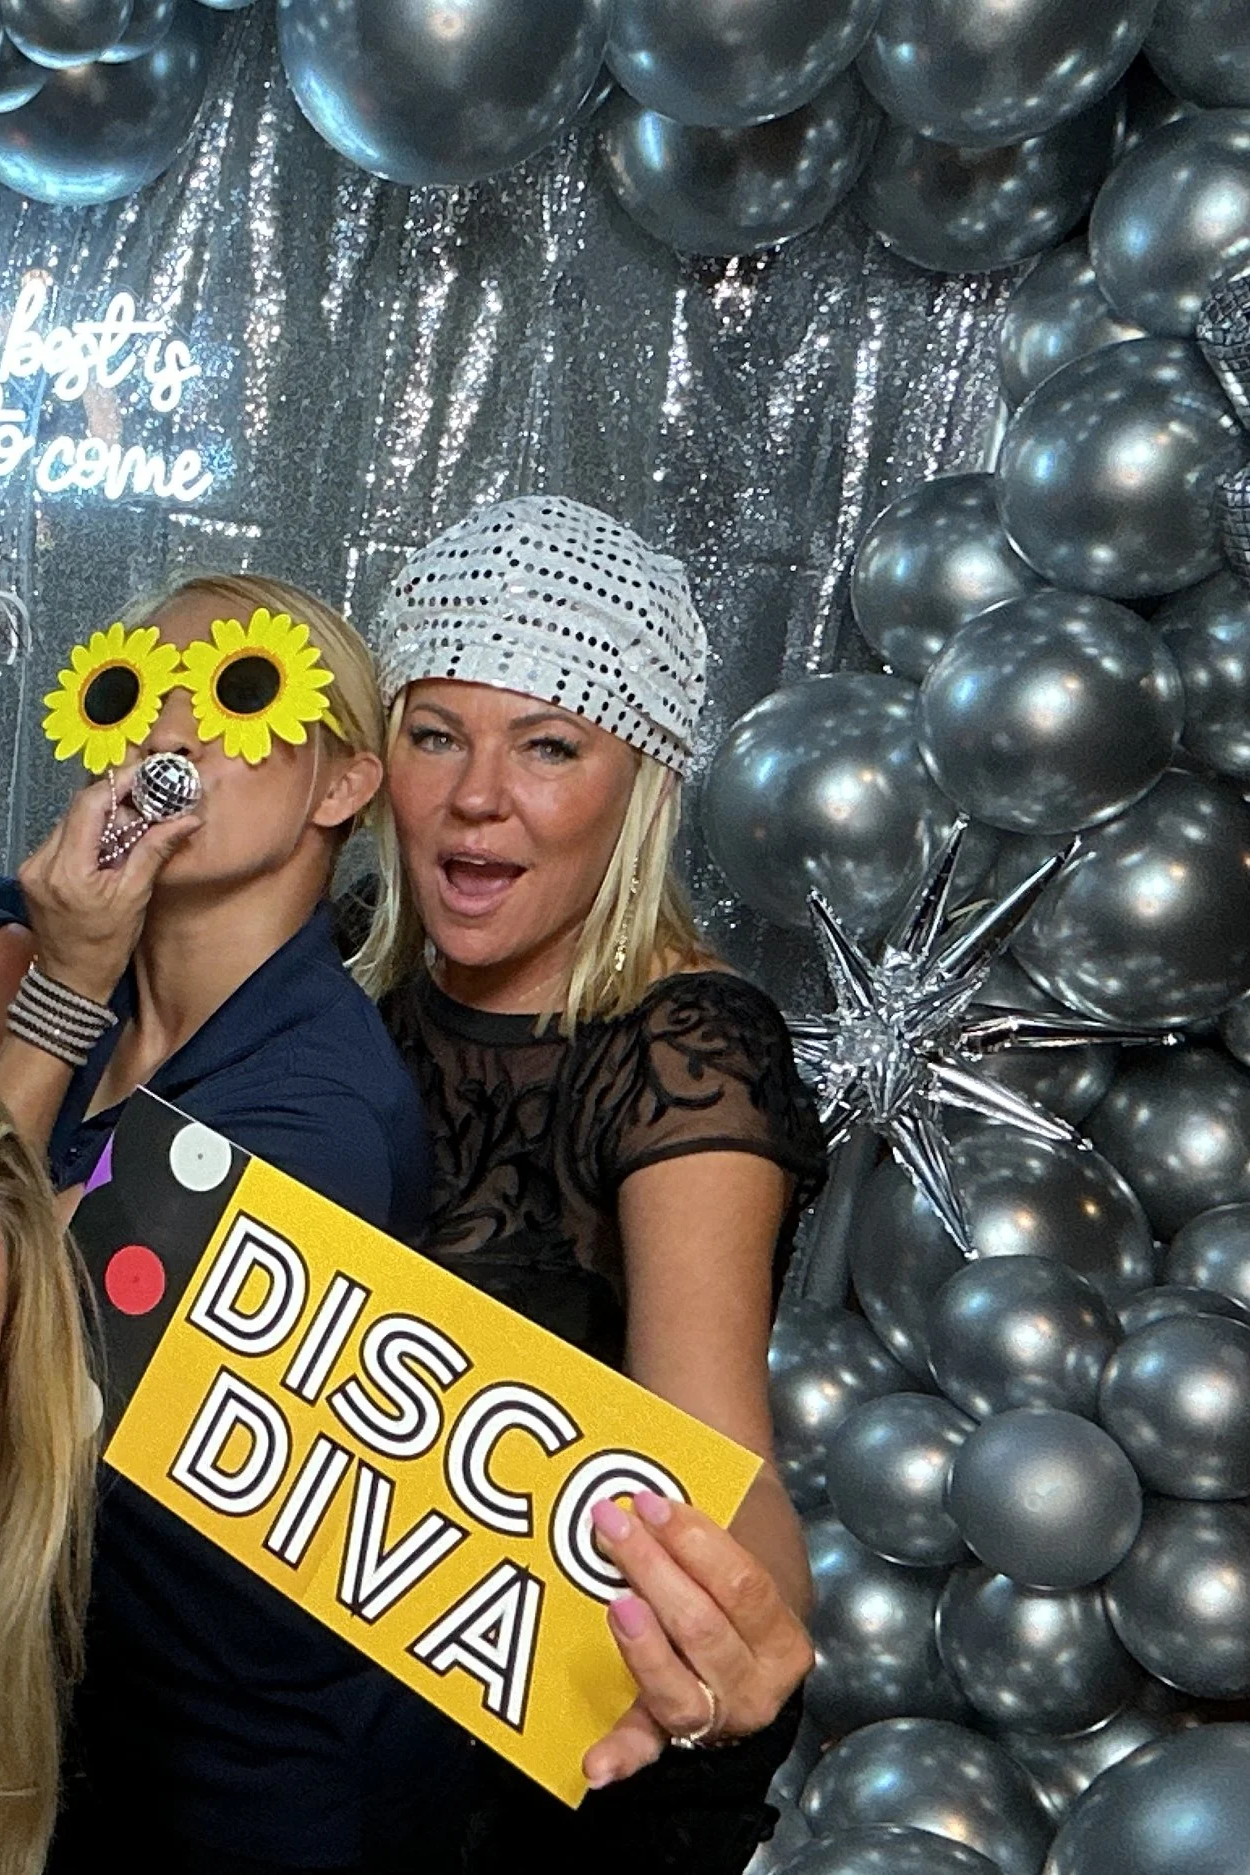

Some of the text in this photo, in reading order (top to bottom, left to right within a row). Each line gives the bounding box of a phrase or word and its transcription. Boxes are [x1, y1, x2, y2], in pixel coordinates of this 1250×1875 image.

[0, 279, 166, 401] best
[144, 340, 202, 413] is
[36, 435, 213, 502] come
[186, 1211, 693, 1603] DISCO
[166, 1367, 546, 1734] DIVA
